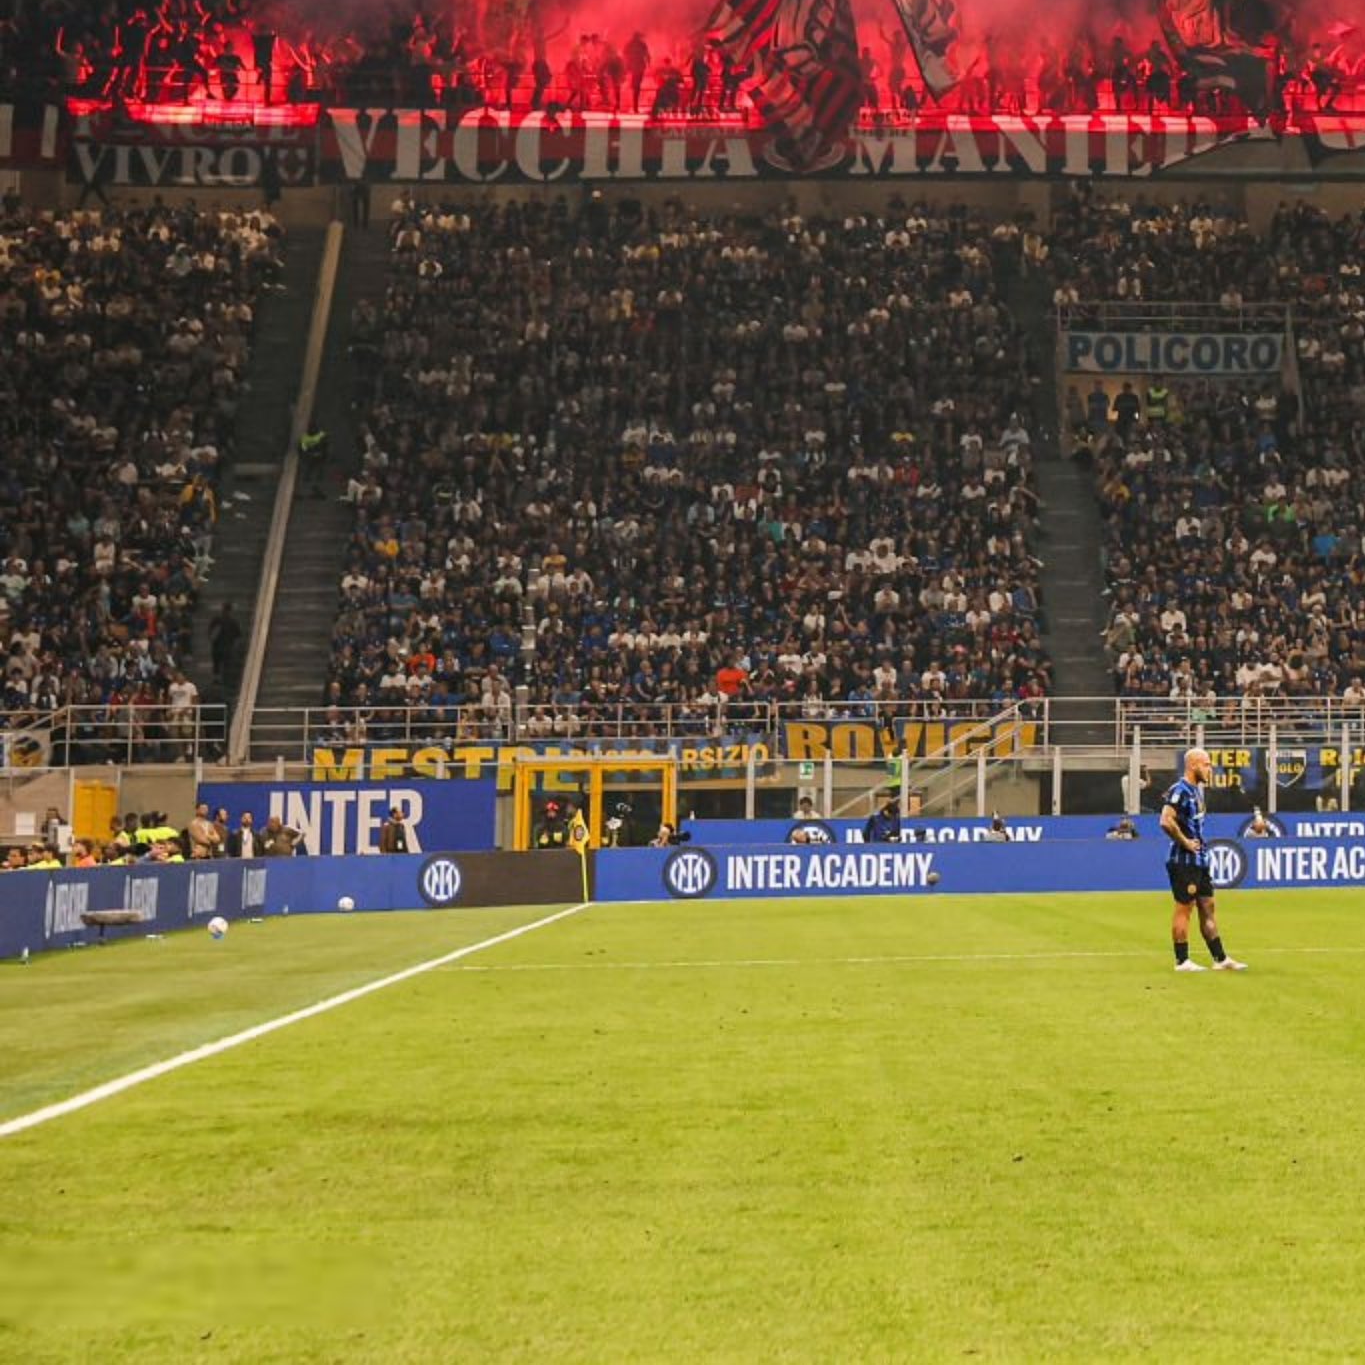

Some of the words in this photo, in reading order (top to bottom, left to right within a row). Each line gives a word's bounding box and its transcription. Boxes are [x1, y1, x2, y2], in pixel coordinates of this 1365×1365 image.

[324, 107, 760, 181] VECCHIA
[1068, 336, 1278, 370] POLICORO
[785, 722, 1037, 762] ROVIGO
[1208, 748, 1252, 769] TER
[268, 790, 424, 856] INTER
[727, 854, 801, 890] INTER
[805, 853, 932, 889] ACADEMY
[1257, 847, 1332, 882] INTER
